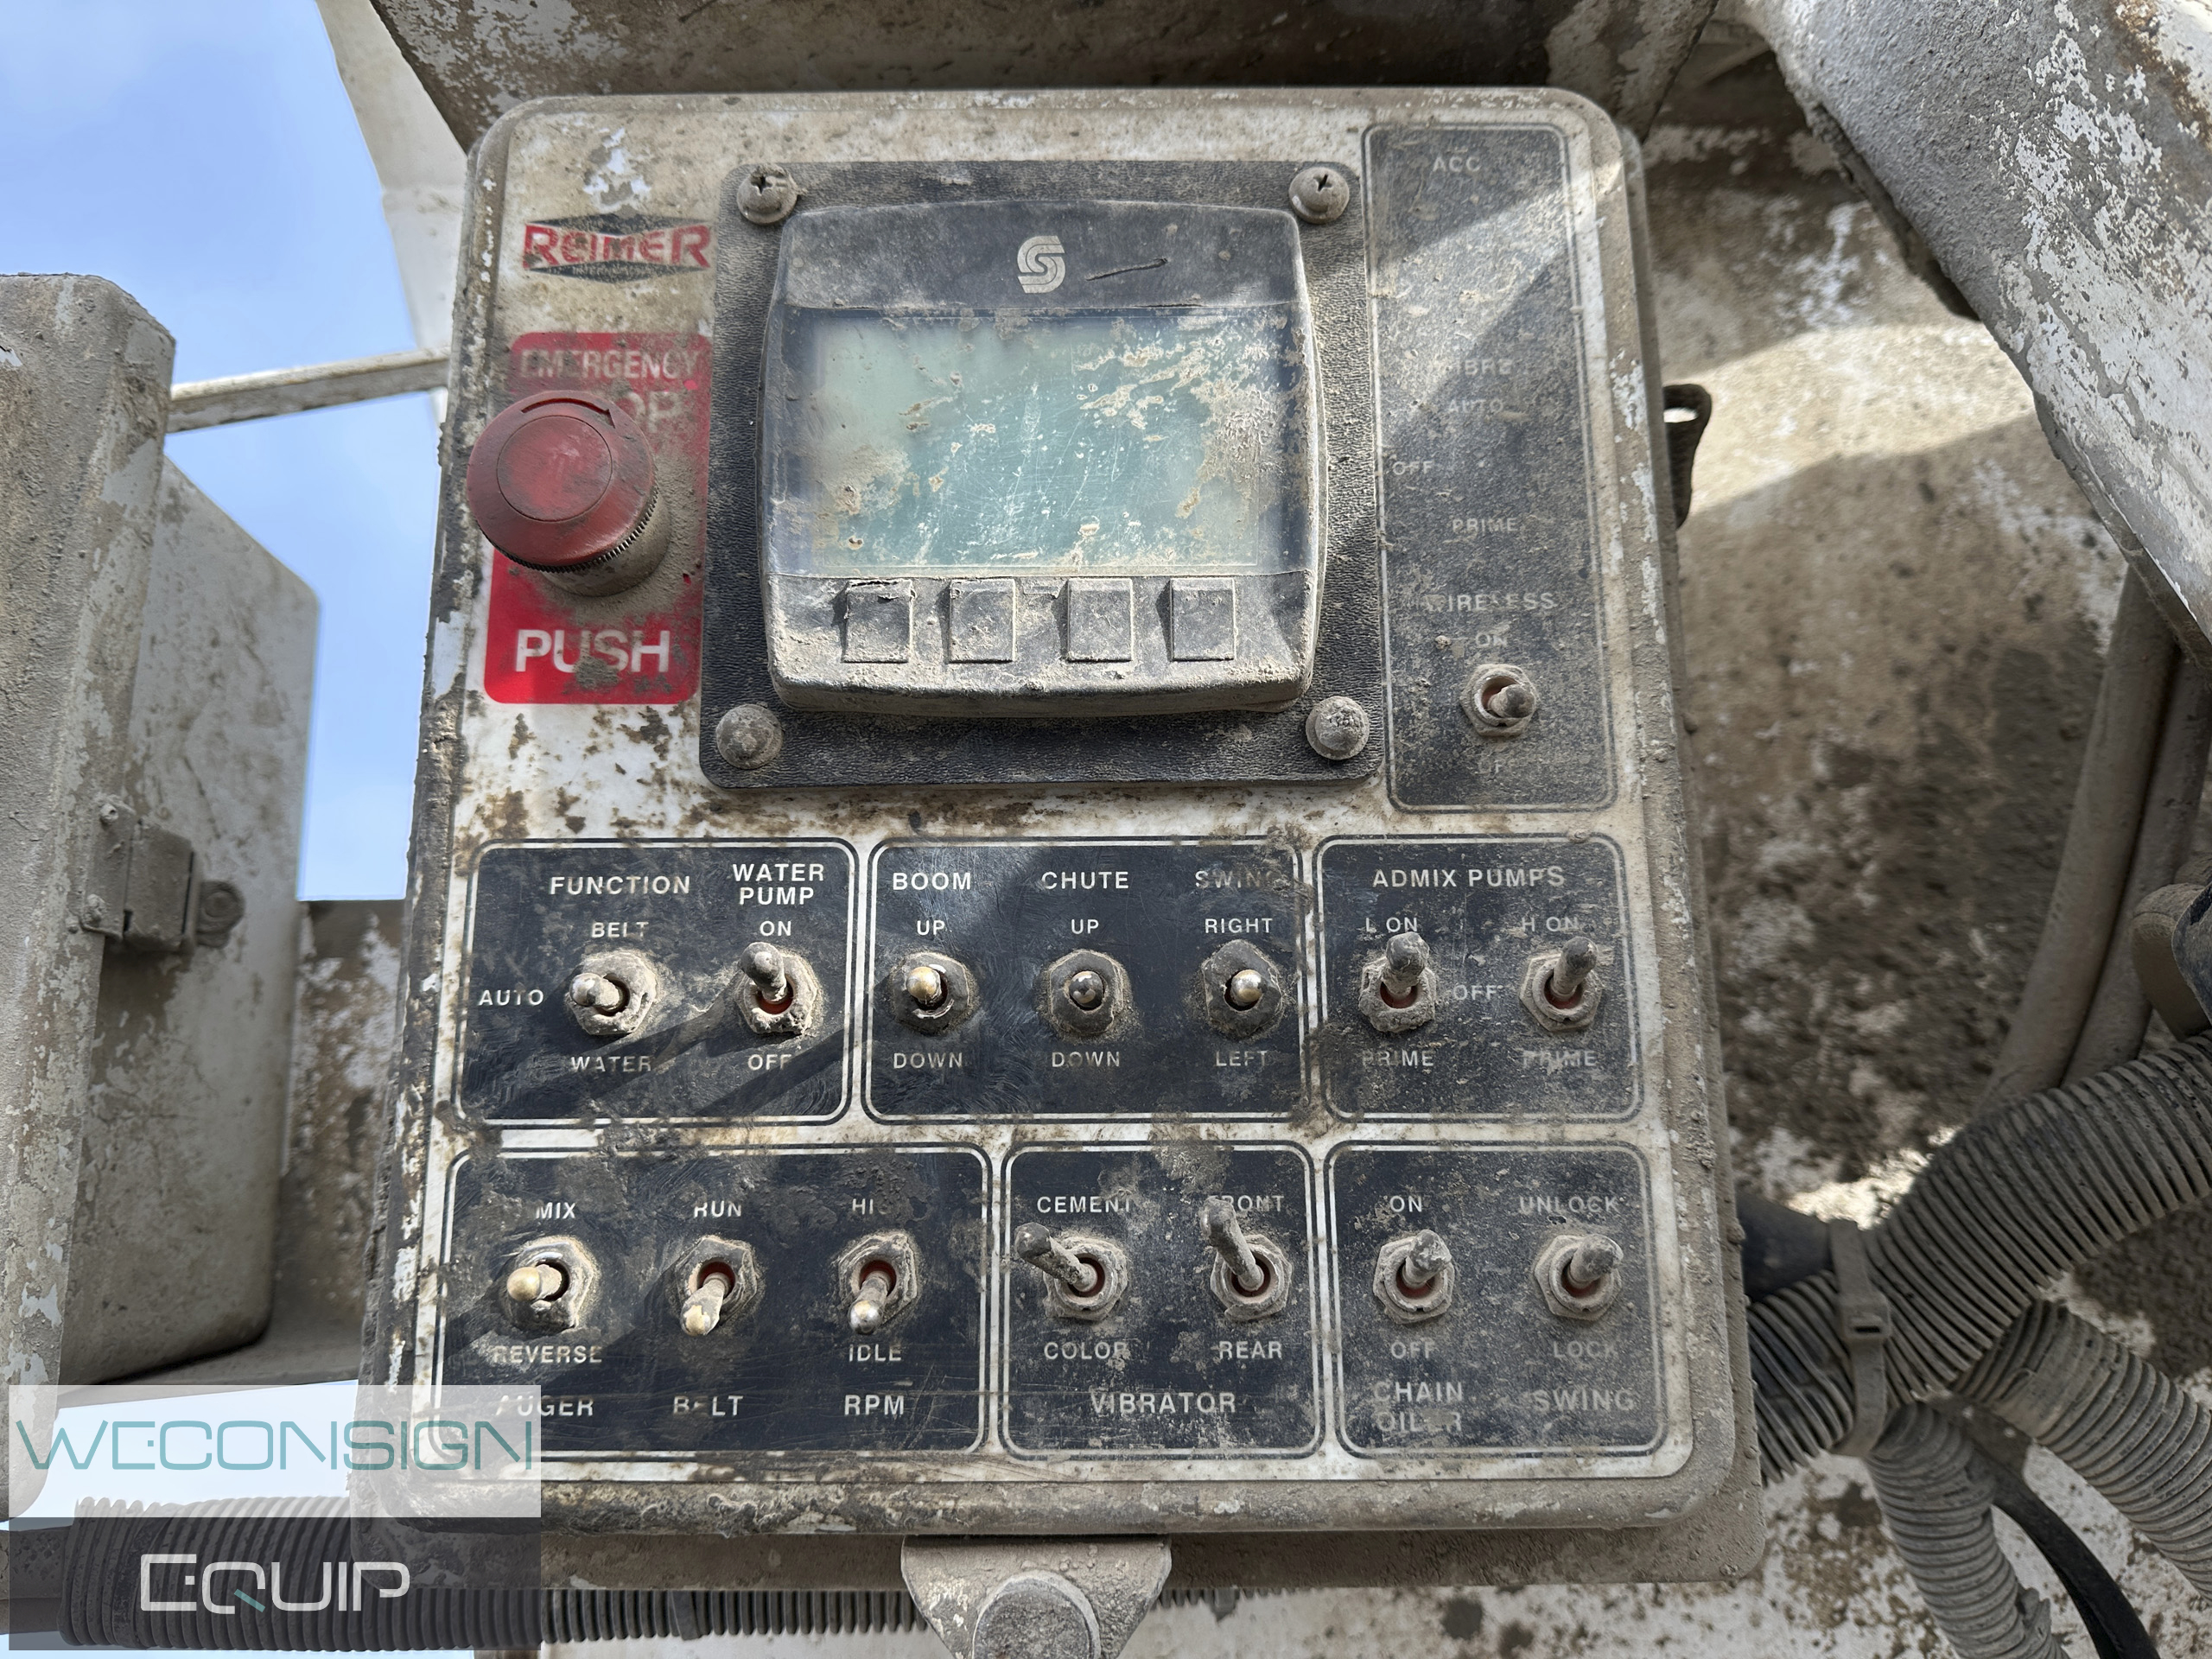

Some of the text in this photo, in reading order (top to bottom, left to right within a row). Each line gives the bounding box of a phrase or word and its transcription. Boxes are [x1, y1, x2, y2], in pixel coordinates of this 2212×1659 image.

[1433, 156, 1481, 173] ACC
[523, 223, 711, 269] REIMER
[521, 348, 701, 379] EMERGENCY
[1392, 461, 1434, 476] OFF
[1452, 518, 1519, 533] PRIME
[1476, 632, 1508, 648] ON
[516, 628, 671, 673] PUSH
[733, 863, 825, 882] WATER
[1040, 870, 1130, 890] CHUTE
[1372, 866, 1566, 888] ADMIX PUMPS
[550, 875, 690, 896] FUNCTION
[893, 872, 972, 892] BOOM
[739, 886, 815, 906] PUMP
[591, 921, 650, 939] BELT
[759, 920, 792, 938] ON
[916, 919, 946, 937] UP
[1071, 918, 1100, 935] UP
[1205, 918, 1273, 935] RIGHT
[1365, 916, 1419, 933] L ON
[1522, 916, 1580, 932] H ON
[478, 988, 544, 1007] AUTO
[1452, 985, 1498, 1001] OFF
[570, 1055, 652, 1072] WATER
[747, 1053, 792, 1071] OFF
[893, 1052, 963, 1070] DOWN
[1052, 1051, 1121, 1069] DOWN
[1216, 1051, 1268, 1068] LEFT
[535, 1202, 577, 1220] MIX
[694, 1202, 743, 1219] RUN
[852, 1198, 874, 1216] HI
[1037, 1195, 1131, 1214] CEMENT
[1208, 1194, 1285, 1212] RONT
[1389, 1195, 1423, 1213] ON
[1519, 1195, 1619, 1213] UNLOCK
[493, 1344, 603, 1363] REVERSE
[849, 1344, 903, 1363] IDLE
[1218, 1340, 1283, 1360] REAR
[1390, 1341, 1436, 1360] OFF
[1554, 1340, 1618, 1358] LOCK
[1373, 1381, 1463, 1402] CHAIN
[672, 1395, 744, 1417] BLT
[844, 1395, 906, 1416] RPM
[1090, 1392, 1236, 1414] VIBRATOR
[1532, 1389, 1636, 1413] SWING
[1375, 1410, 1462, 1433] OILR
